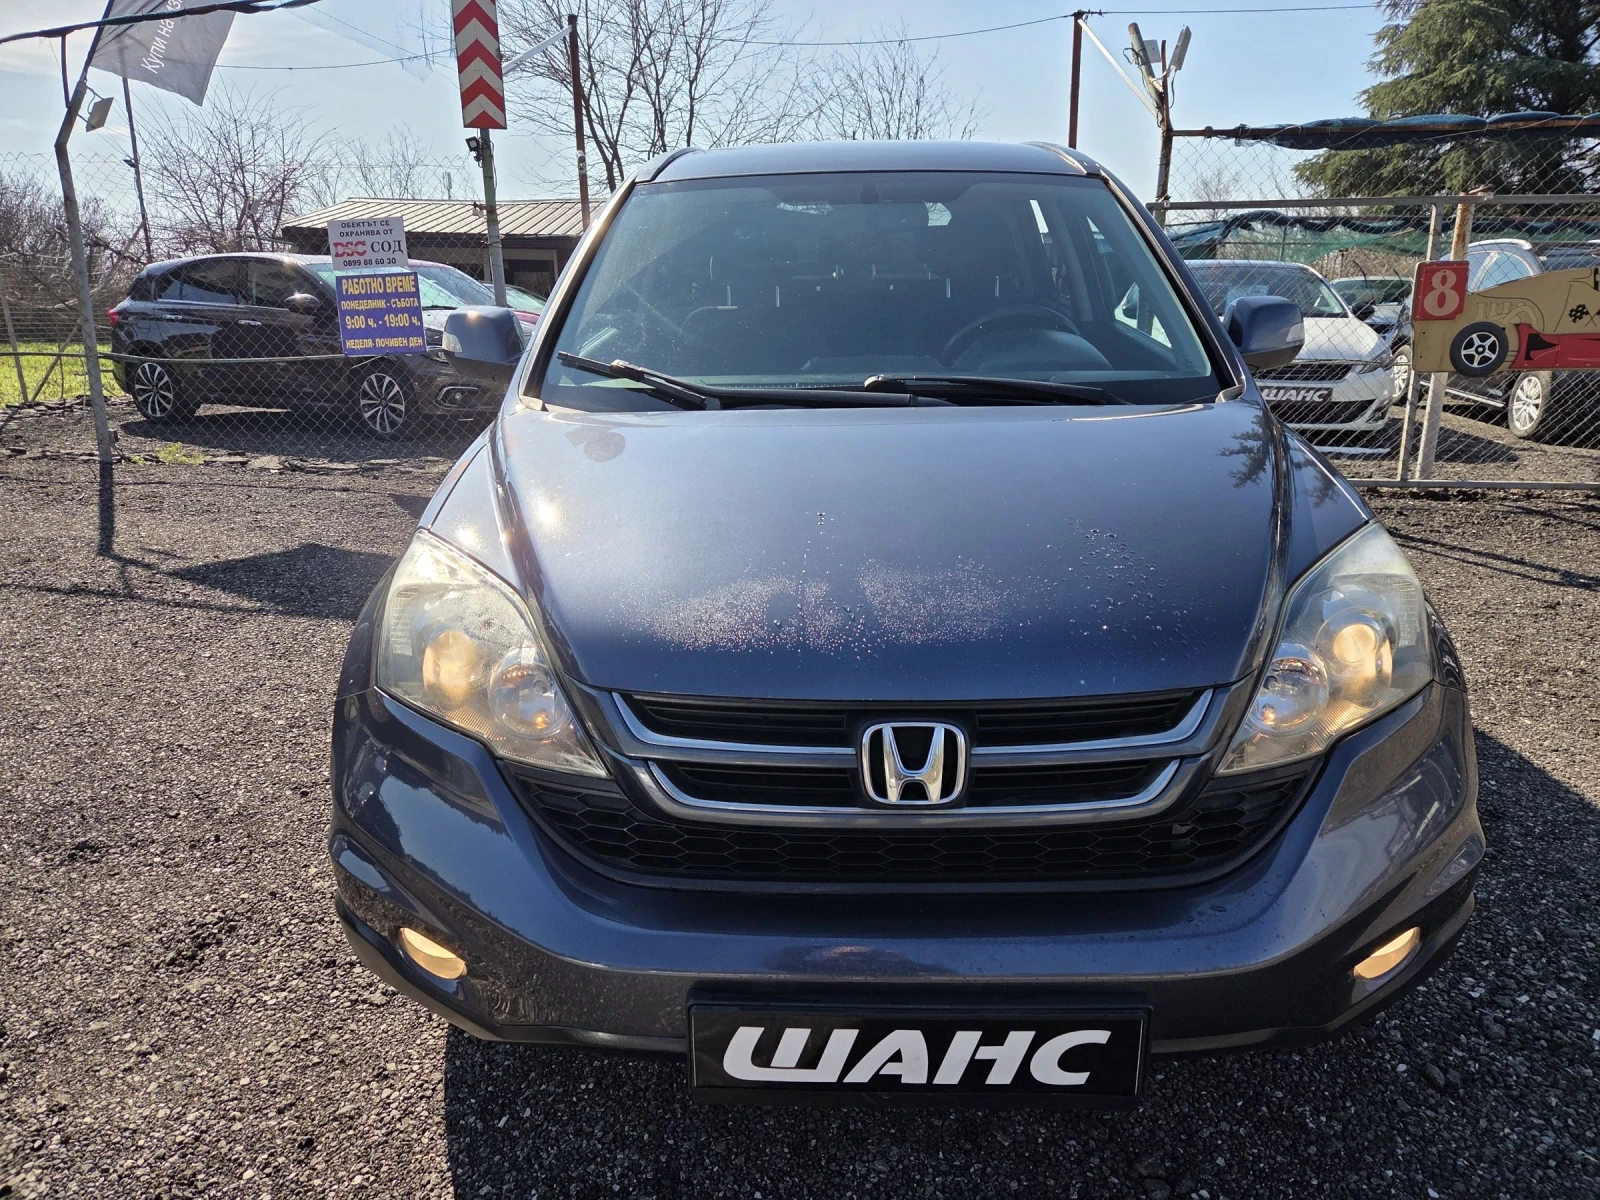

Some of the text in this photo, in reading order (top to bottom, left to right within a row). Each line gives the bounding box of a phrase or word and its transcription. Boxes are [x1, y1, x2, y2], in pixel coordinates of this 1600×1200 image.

[141, 36, 168, 74] Купи
[339, 230, 380, 238] ОХРАНЯВА
[333, 240, 403, 258] DSC СОД
[343, 259, 361, 267] 0899
[363, 258, 373, 266] 88
[387, 257, 397, 265] 30
[341, 275, 416, 295] РАБОТНО ВРЕМЕ
[1424, 269, 1460, 316] 8
[341, 299, 386, 311] ПОНЕДЕЛНИК
[390, 297, 419, 308] СЪБОТА
[345, 314, 366, 329] 9:00
[384, 313, 410, 327] 19:00
[375, 336, 408, 348] ПОЧИВЕН
[409, 336, 423, 348] ДЕН
[722, 1025, 1112, 1086] ШАНС
